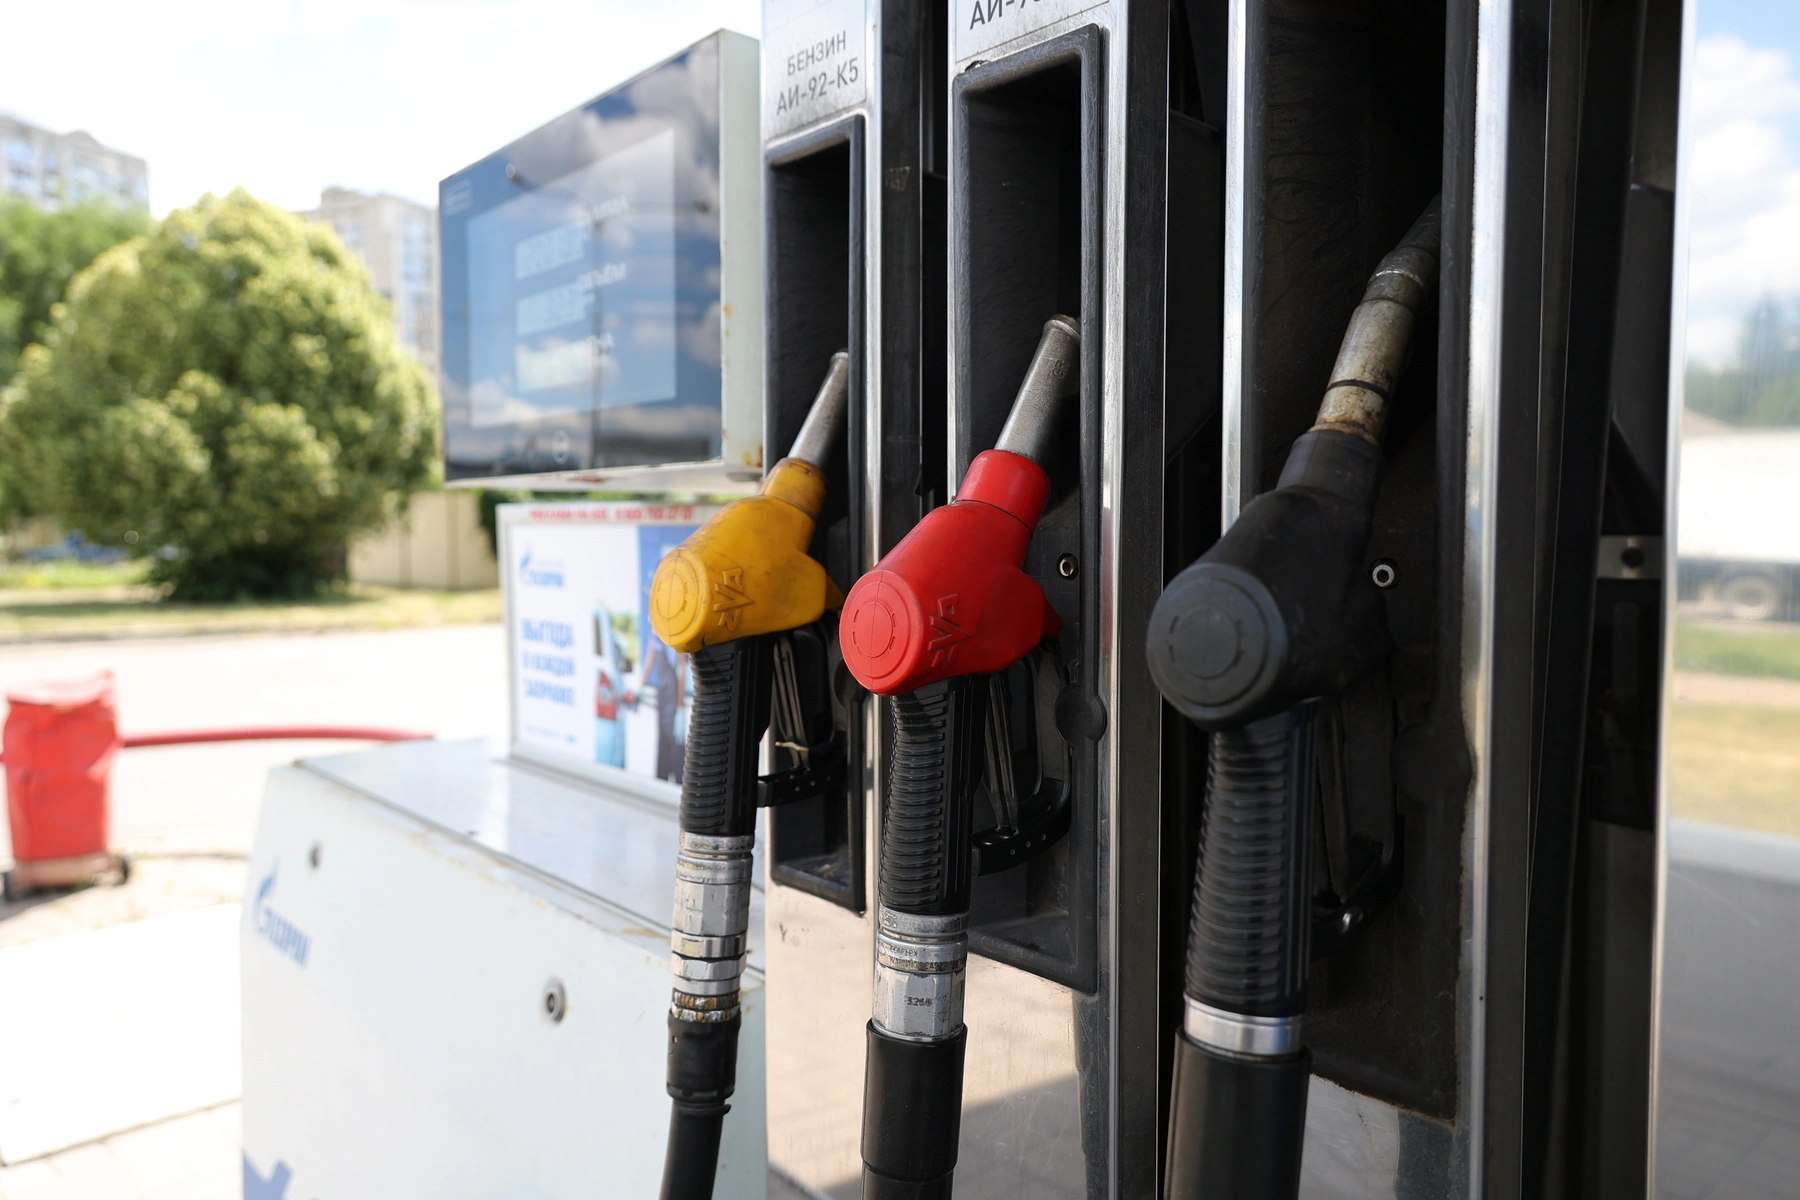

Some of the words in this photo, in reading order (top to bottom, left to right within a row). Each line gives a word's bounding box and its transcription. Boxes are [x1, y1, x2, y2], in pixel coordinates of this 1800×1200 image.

[969, 0, 1042, 31] АИ-
[787, 30, 847, 77] БЕНЗИН
[776, 56, 859, 116] АИ-92-К5
